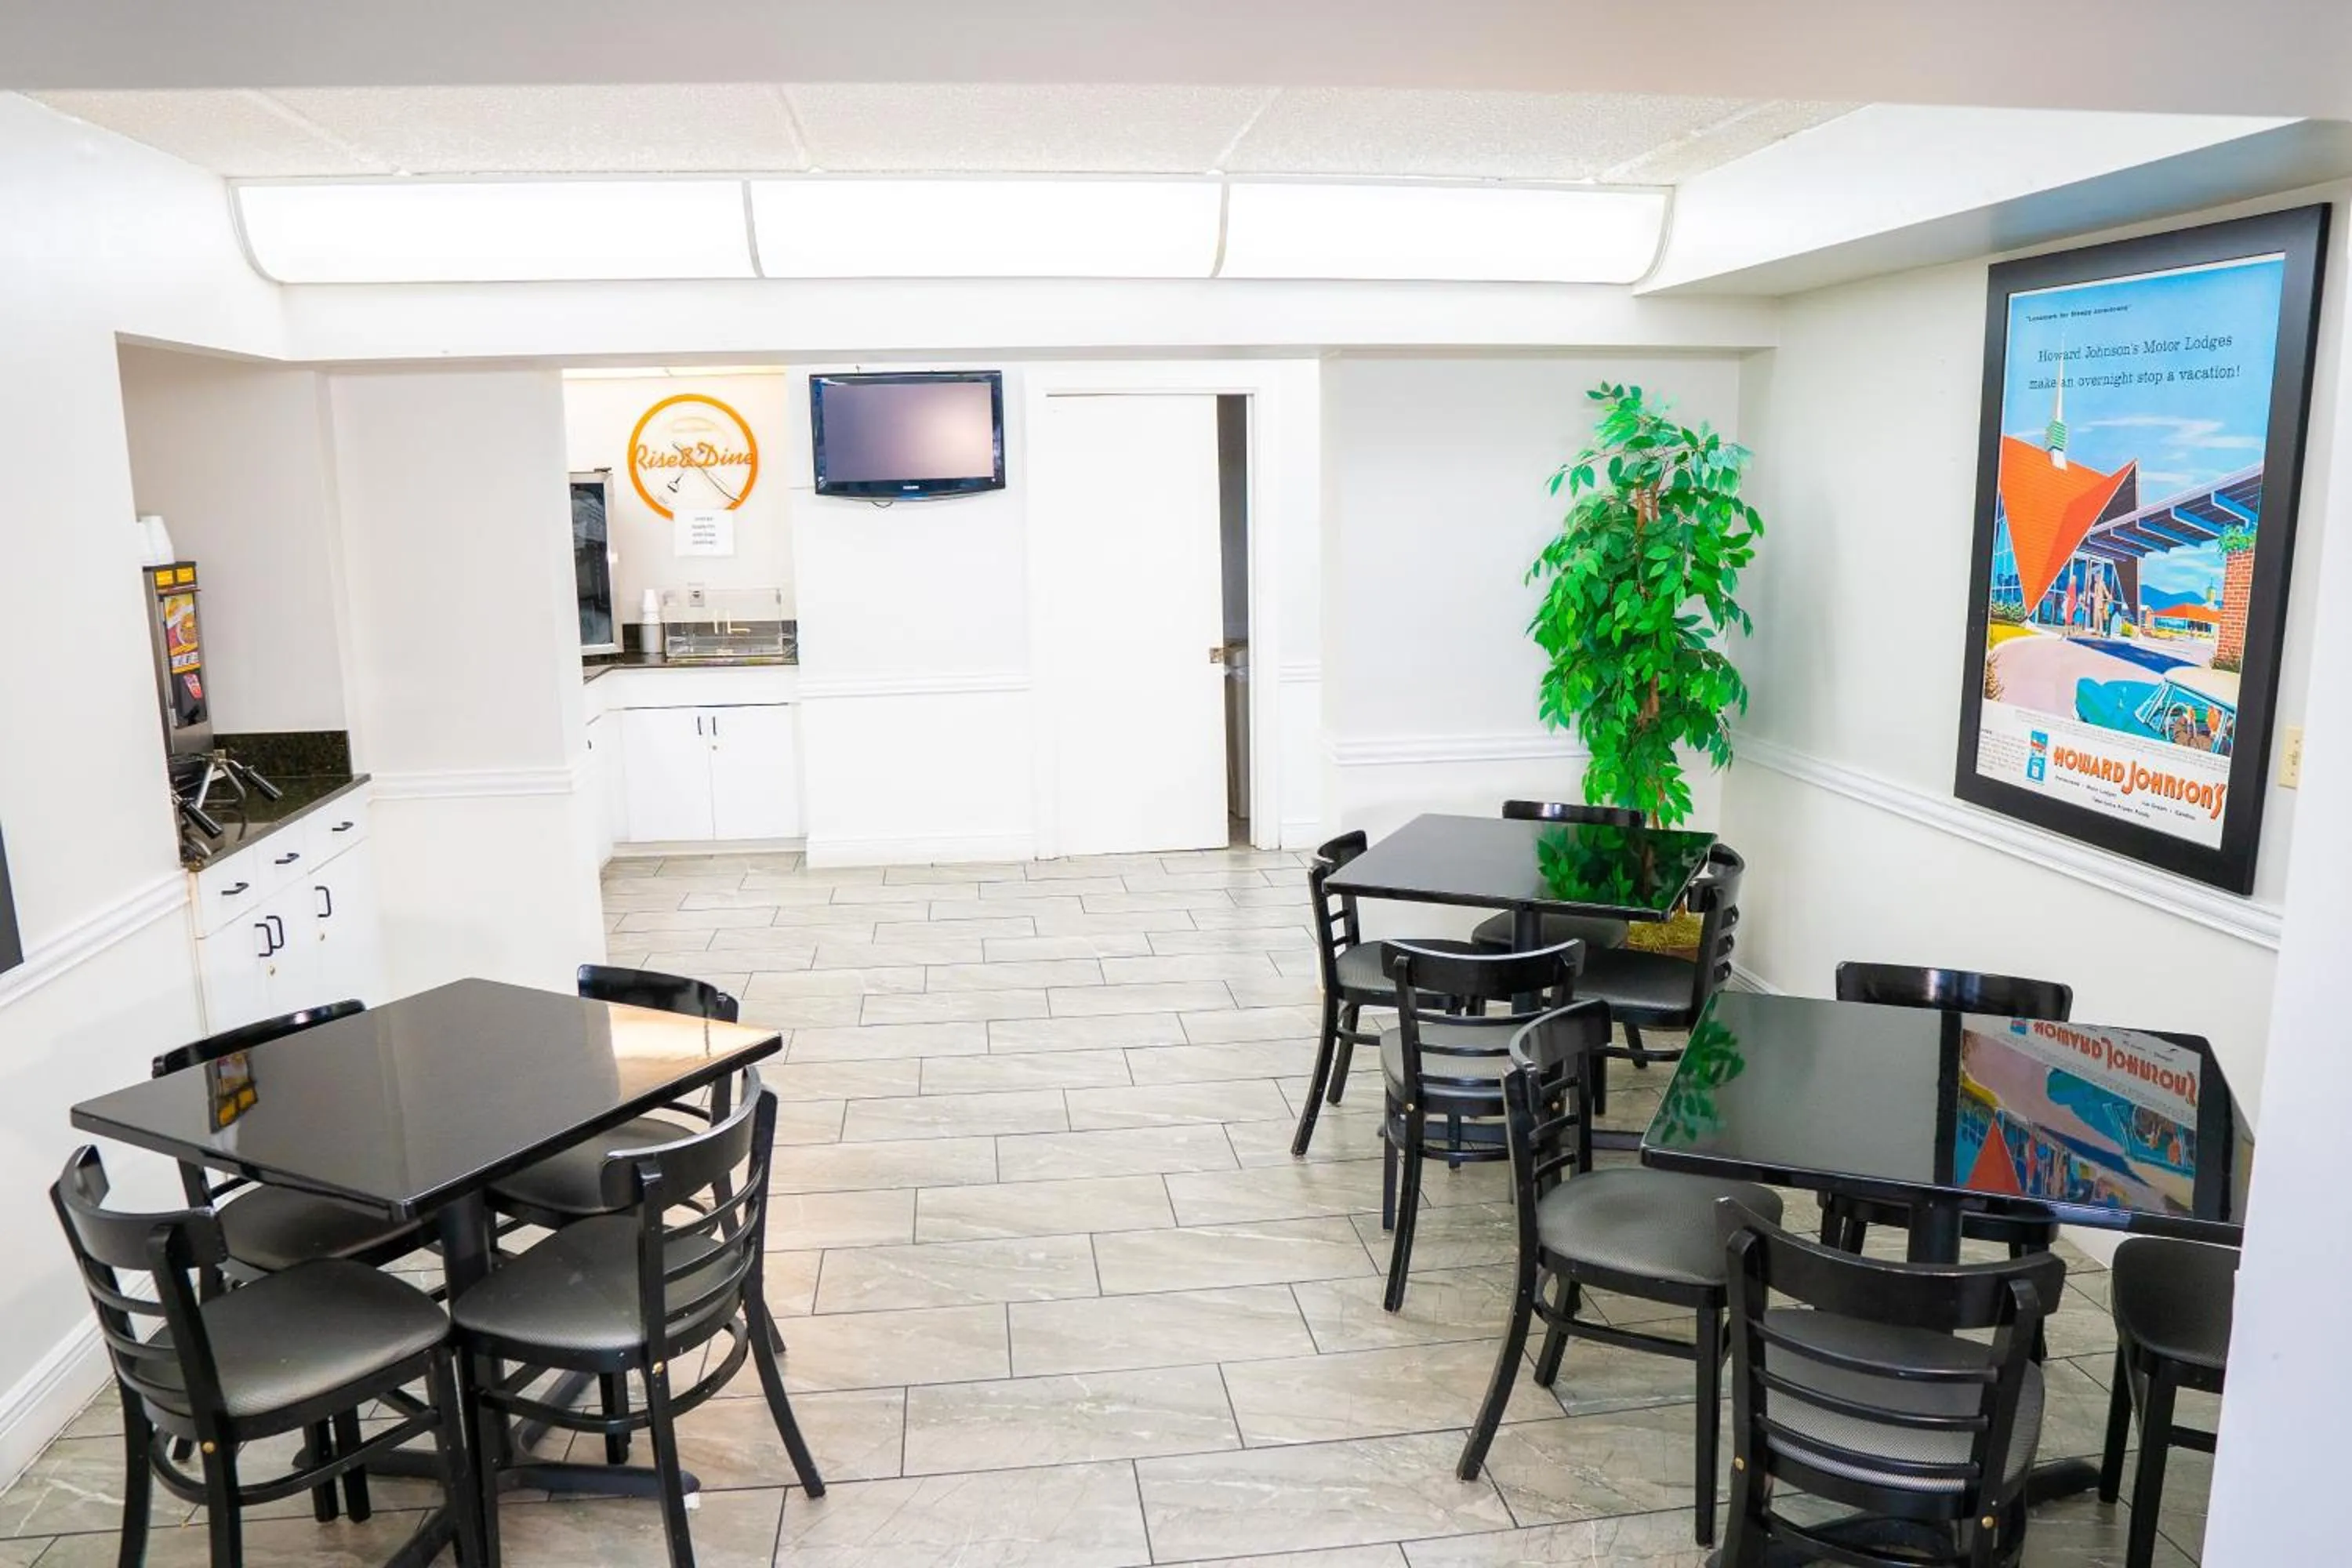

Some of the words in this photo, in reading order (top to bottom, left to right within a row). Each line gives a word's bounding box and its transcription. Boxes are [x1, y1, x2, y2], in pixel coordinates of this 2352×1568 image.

[2038, 347, 2082, 361] Howard
[2085, 343, 2139, 358] Johnson's
[2143, 339, 2180, 354] Motor
[2184, 335, 2233, 351] Lodges
[2028, 378, 2057, 389] make
[2061, 378, 2074, 388] an
[2078, 372, 2133, 388] overnight
[2136, 372, 2163, 385] stop
[2166, 370, 2176, 382] a
[2179, 365, 2241, 381] vacation!
[2053, 746, 2126, 783] HOWARD
[2121, 760, 2227, 820] JOHNSON'S
